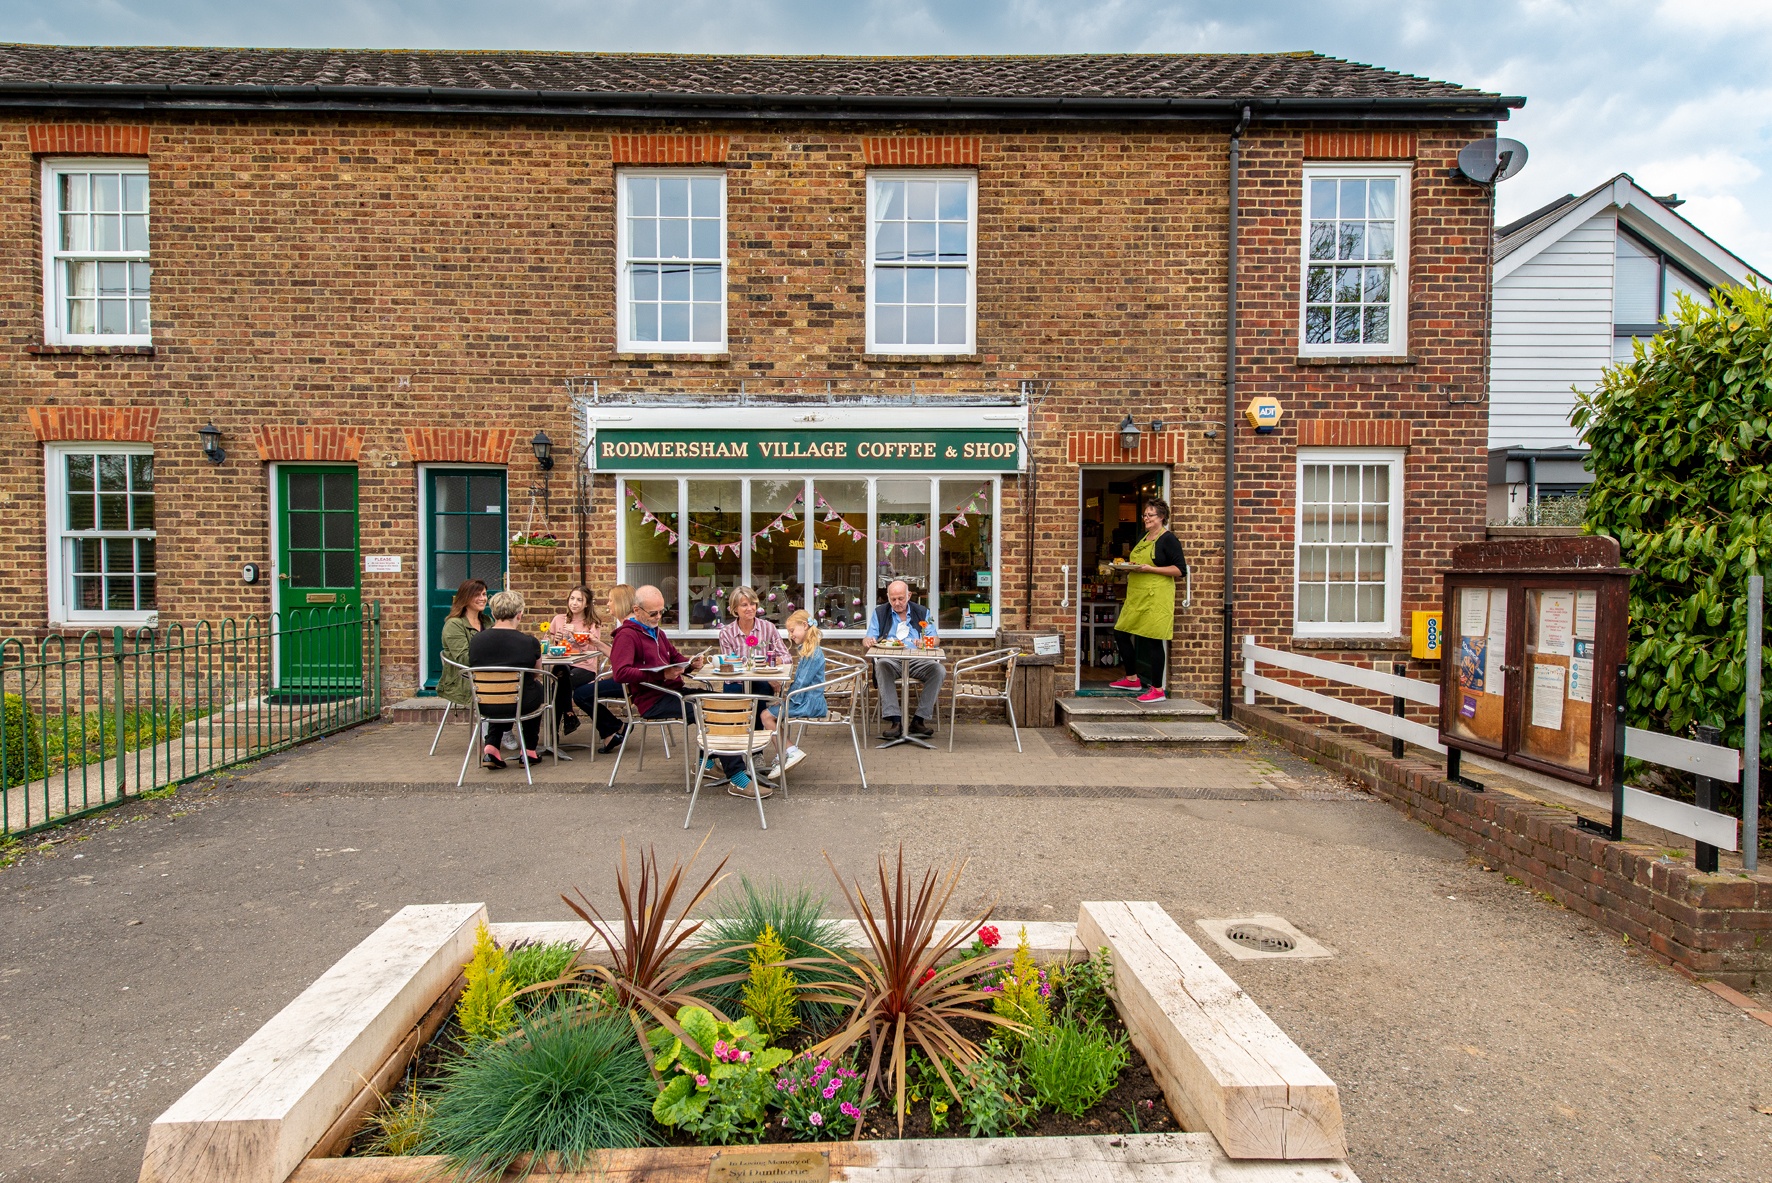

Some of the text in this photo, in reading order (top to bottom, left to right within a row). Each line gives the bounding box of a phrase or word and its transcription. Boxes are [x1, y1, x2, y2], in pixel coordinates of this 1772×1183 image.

[1259, 408, 1276, 416] ADT
[601, 441, 1017, 458] RODMERSHAM VILLAGE COFFEE & SHOP
[340, 593, 346, 604] 3
